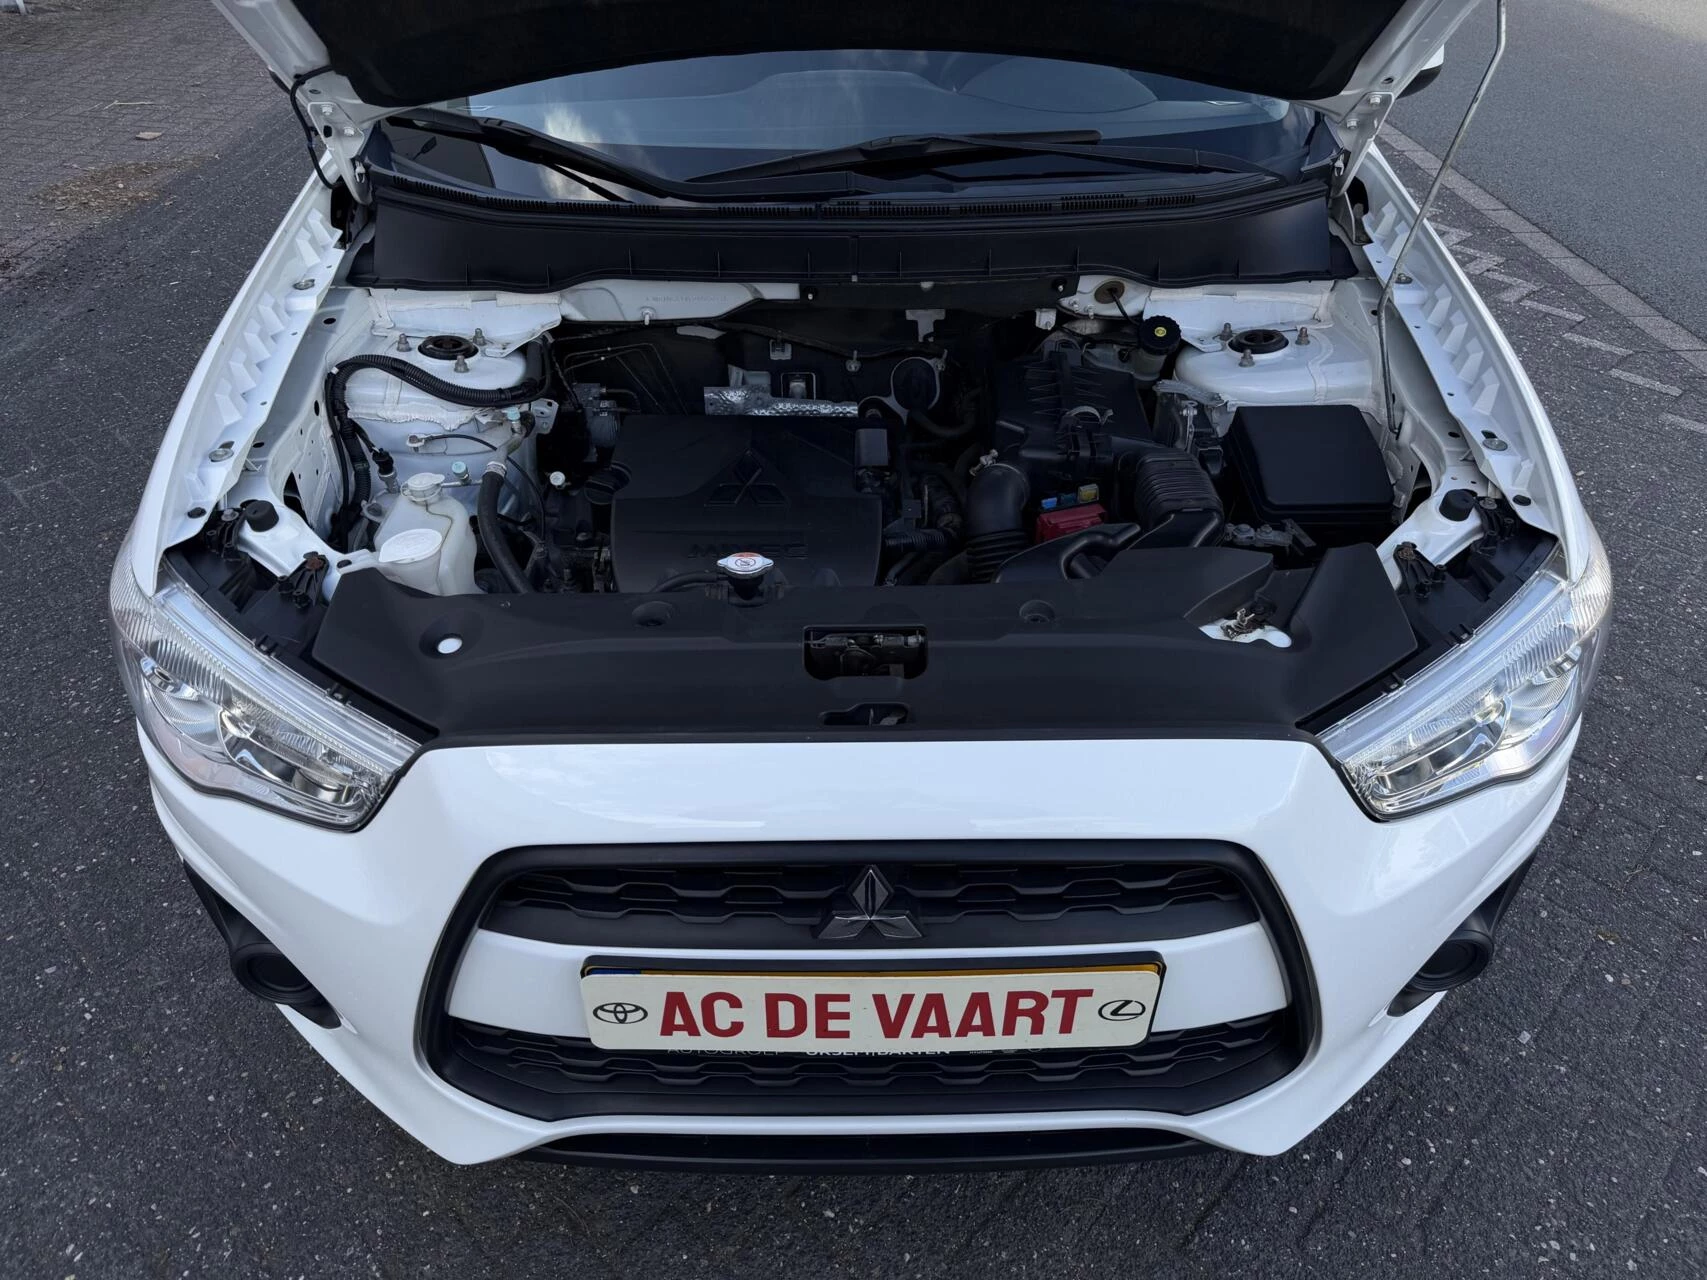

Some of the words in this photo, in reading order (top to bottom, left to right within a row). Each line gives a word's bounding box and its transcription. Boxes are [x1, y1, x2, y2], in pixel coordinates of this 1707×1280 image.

[660, 991, 744, 1038] AC
[765, 993, 850, 1039] DE
[872, 989, 1093, 1038] VAART
